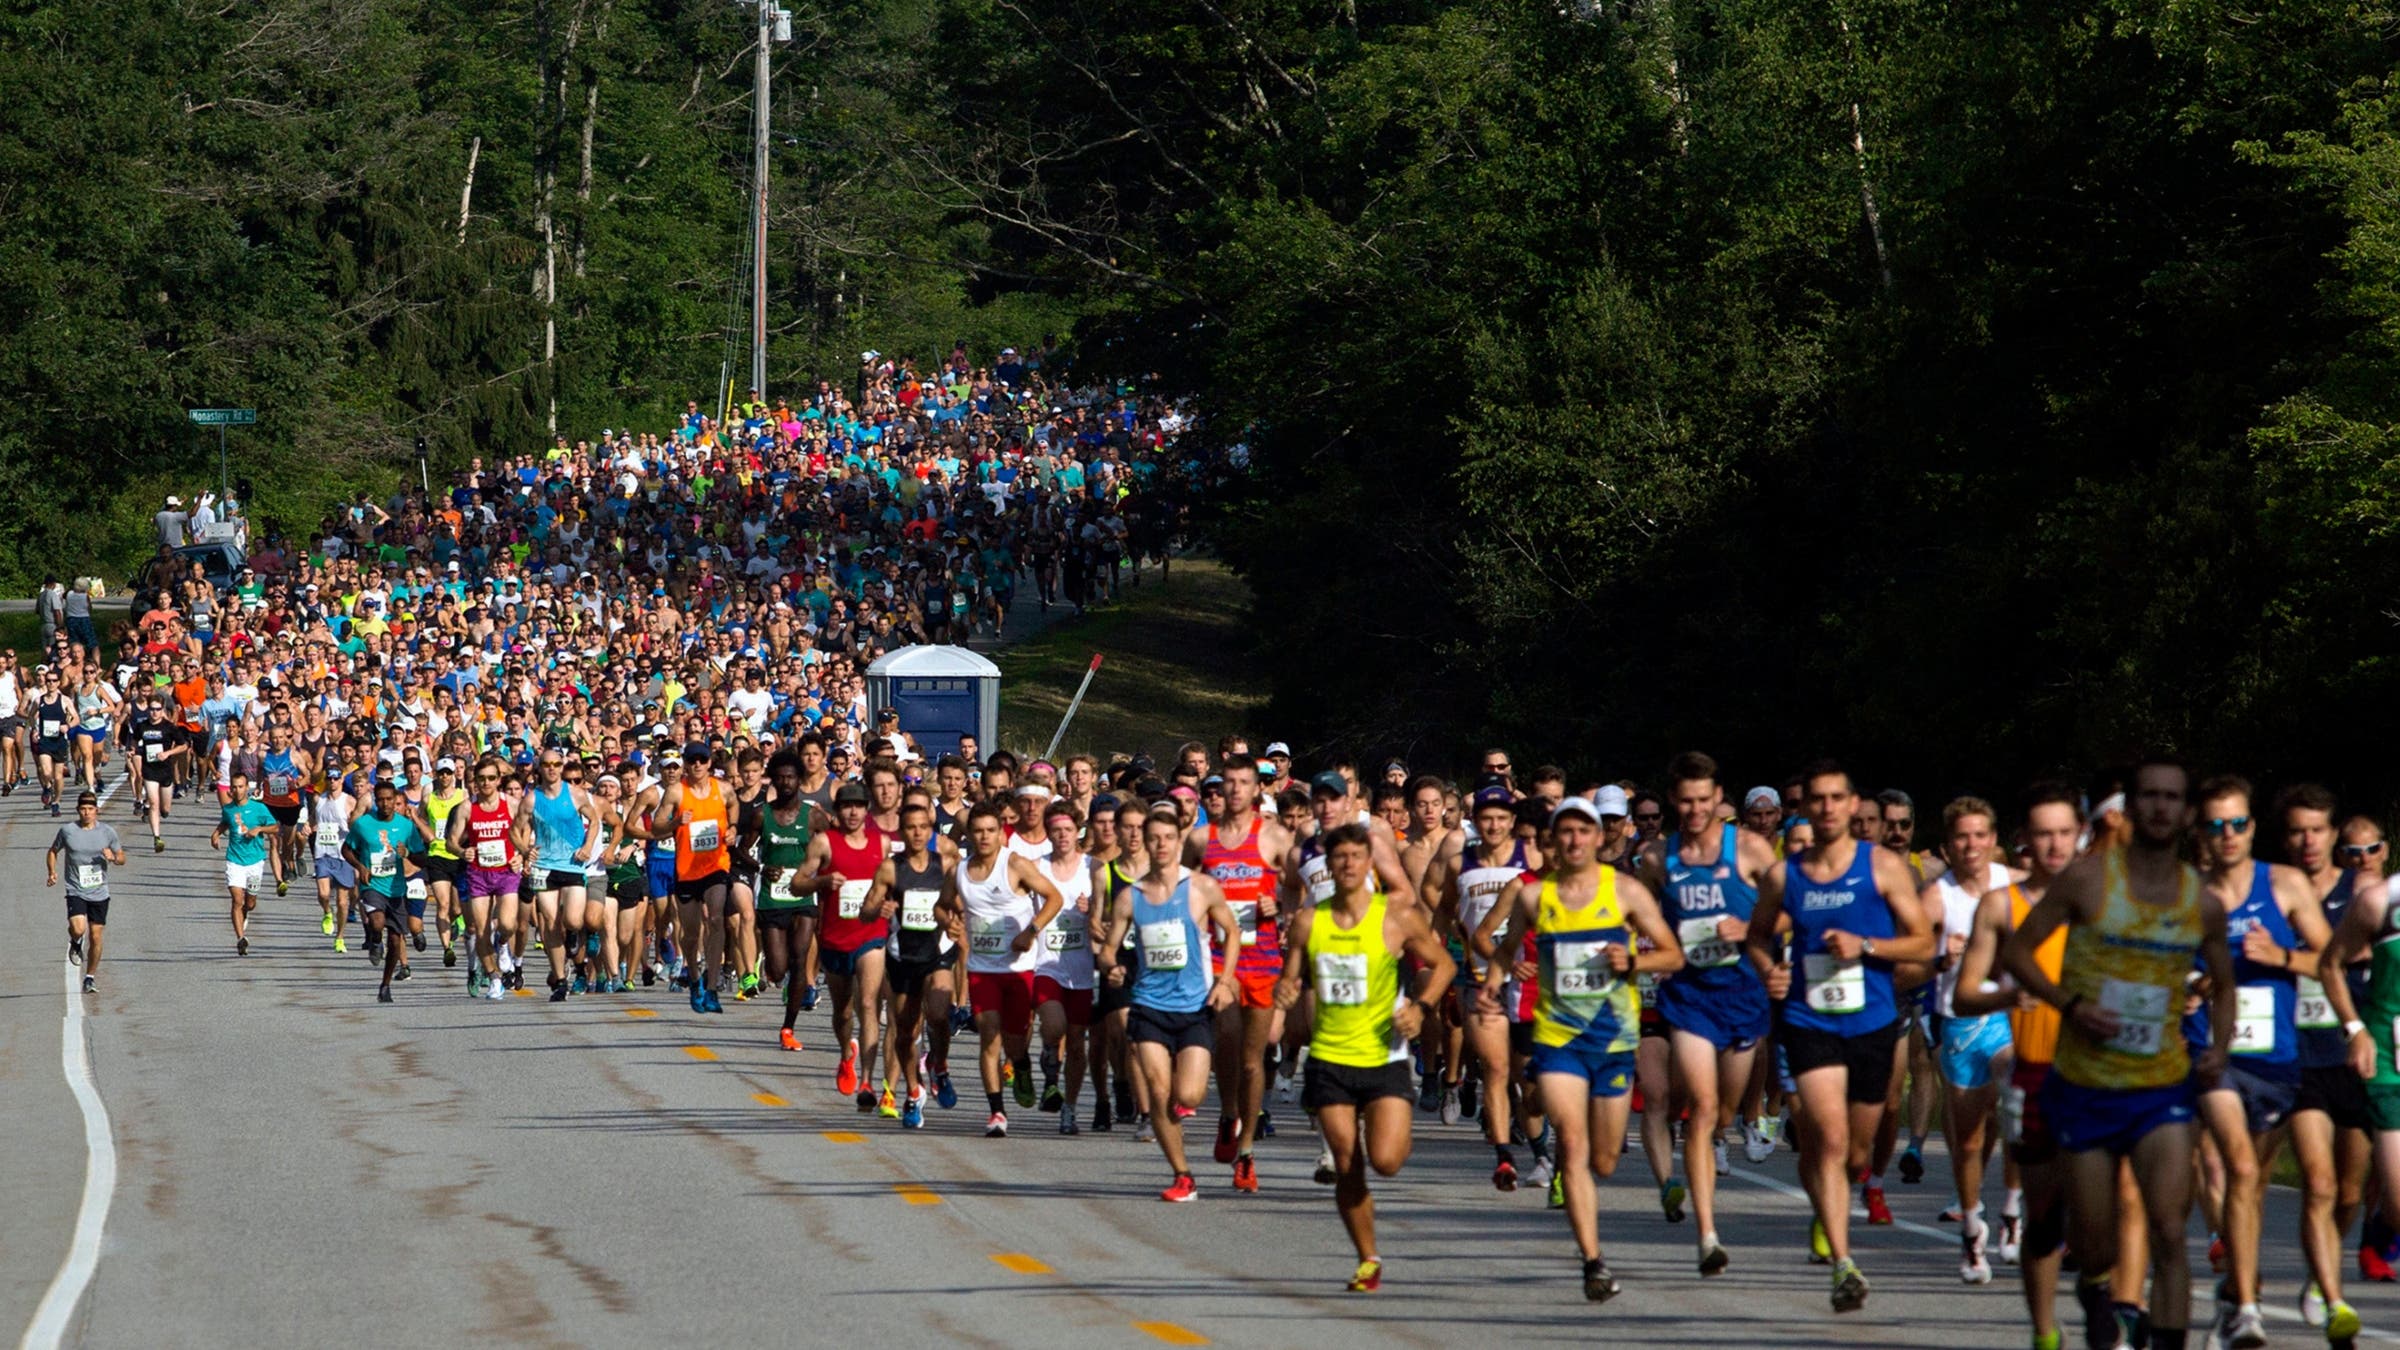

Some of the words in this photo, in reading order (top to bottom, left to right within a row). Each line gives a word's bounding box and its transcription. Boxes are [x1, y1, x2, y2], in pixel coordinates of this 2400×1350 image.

[192, 411, 230, 422] Monastery
[233, 410, 242, 420] Rd
[472, 820, 509, 830] RUNNER'S
[478, 829, 502, 838] ALLEY
[694, 836, 717, 848] 3833
[1680, 884, 1726, 911] USA
[1804, 891, 1855, 907] Dirigo
[974, 936, 1001, 947] 5067
[1050, 932, 1081, 945] 2788
[1149, 949, 1183, 962] 7066
[1331, 982, 1351, 997] 65
[2301, 1003, 2326, 1017] 39
